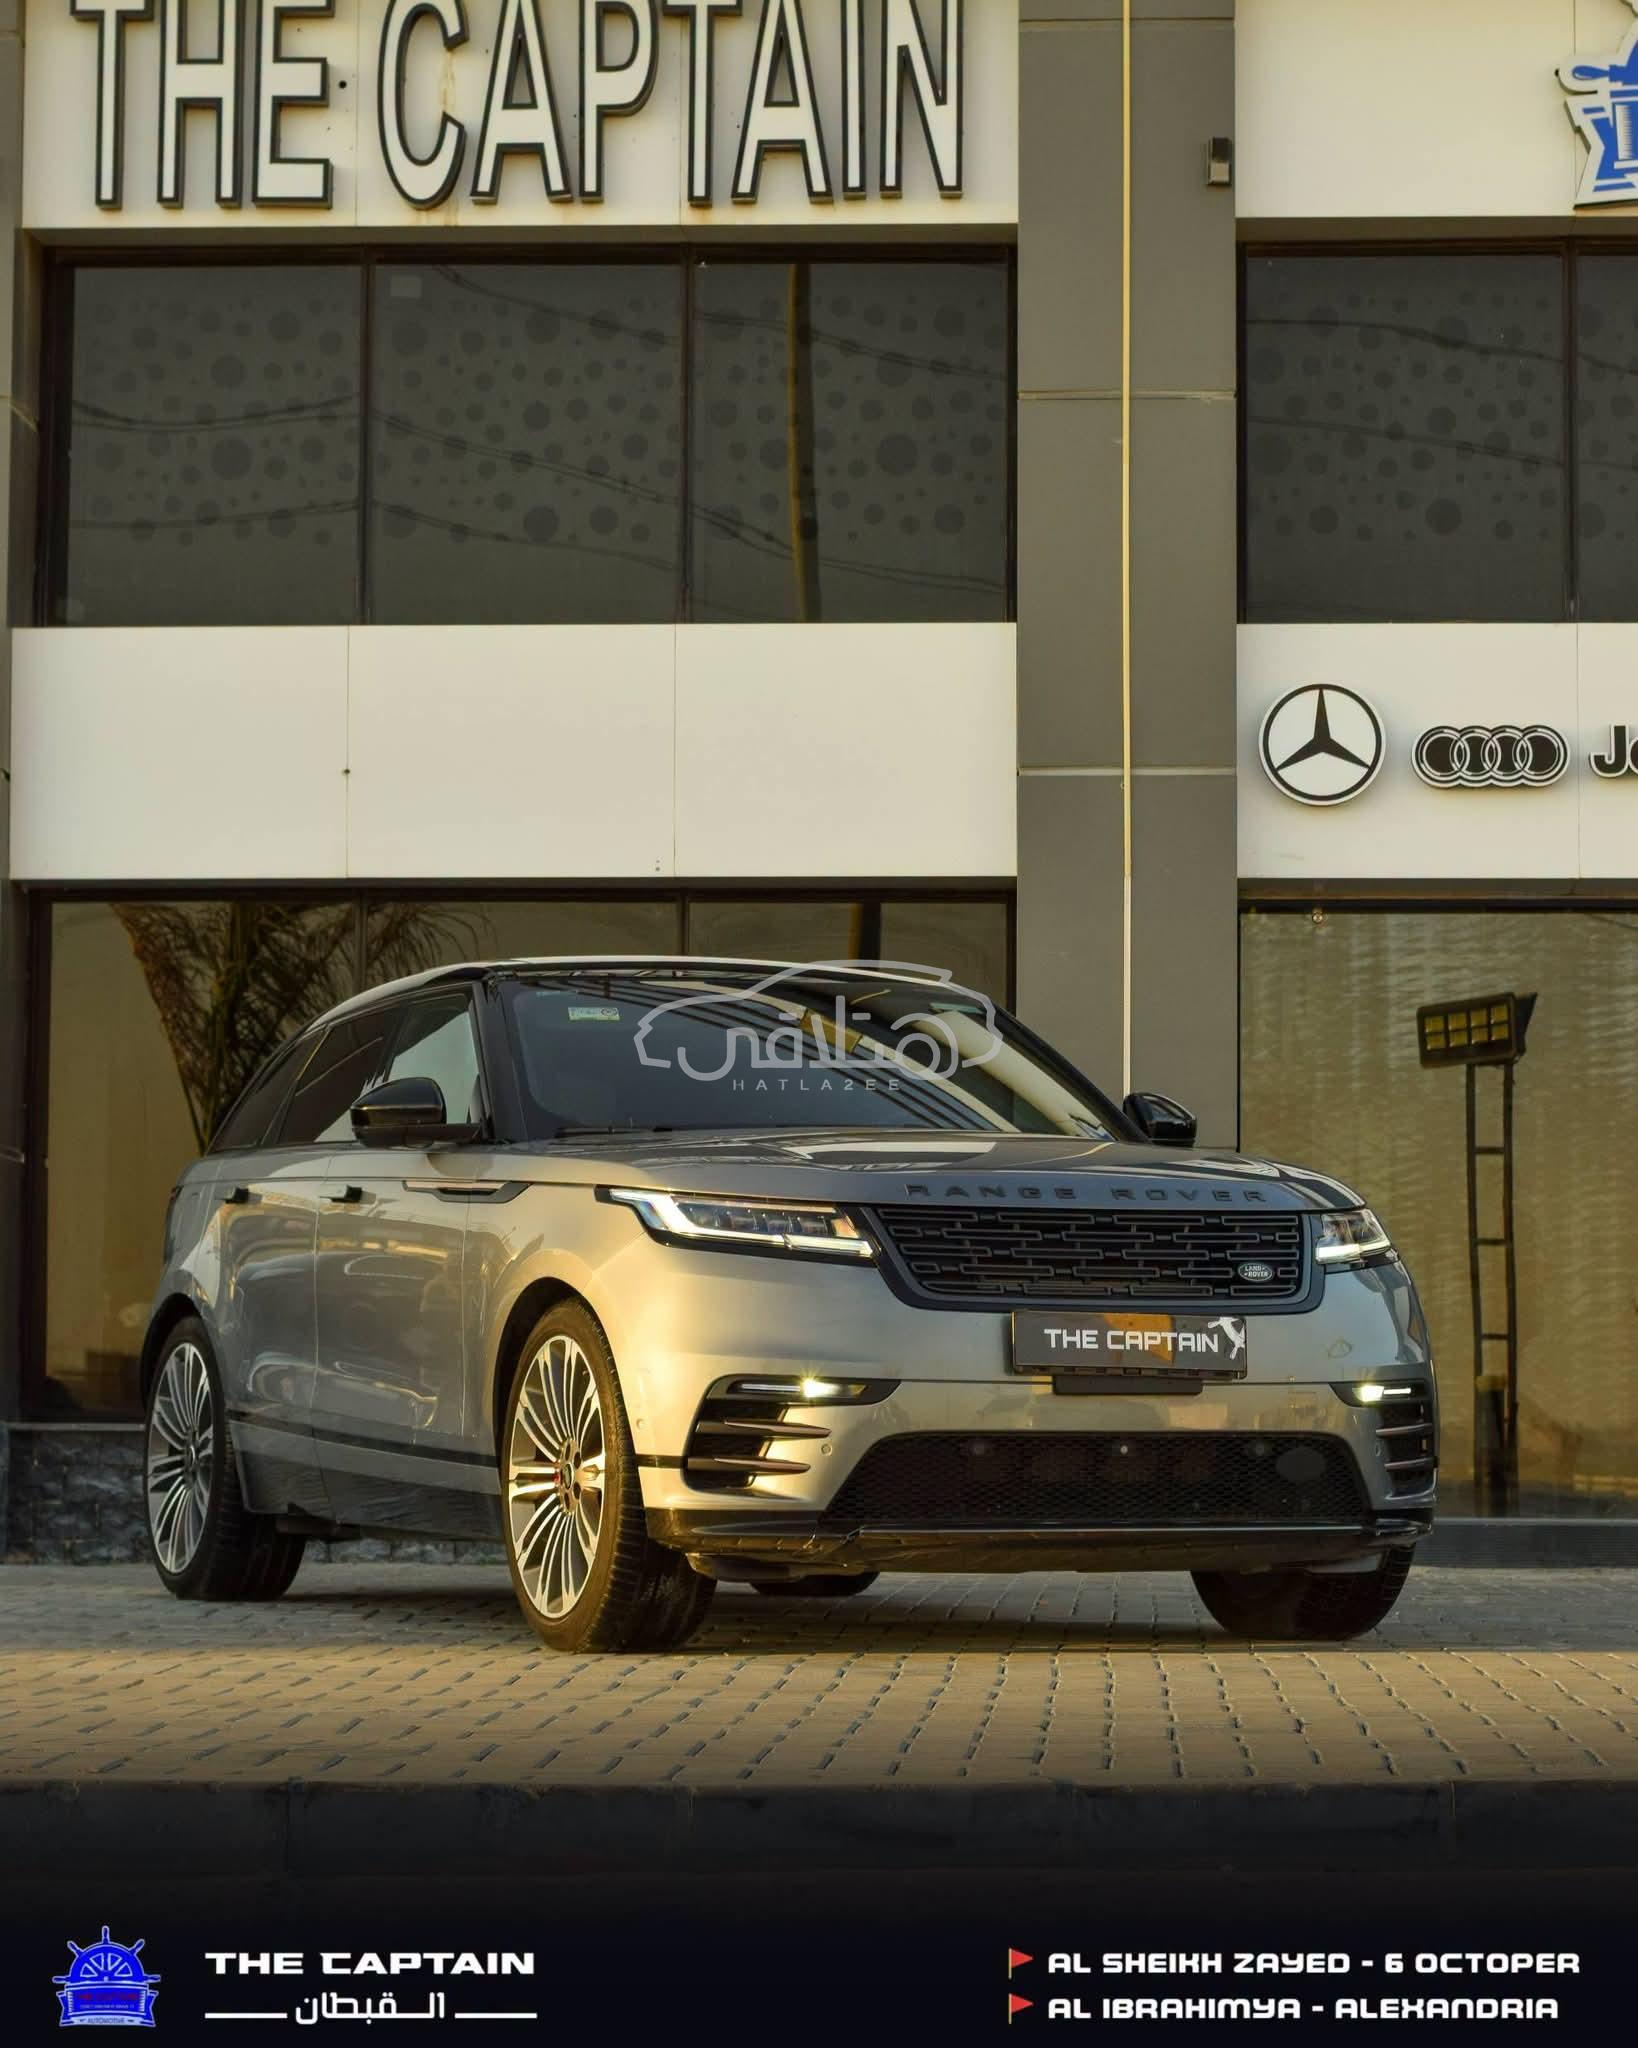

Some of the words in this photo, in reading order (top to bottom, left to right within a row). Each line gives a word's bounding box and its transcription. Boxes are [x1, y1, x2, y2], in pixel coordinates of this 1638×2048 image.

[71, 0, 334, 208] THE
[378, 0, 963, 210] CAPTAIN
[905, 1183, 1077, 1201] RANGE
[1111, 1188, 1266, 1203] ROVER
[1044, 1328, 1099, 1350] THE
[1106, 1330, 1219, 1353] CAPTAIN
